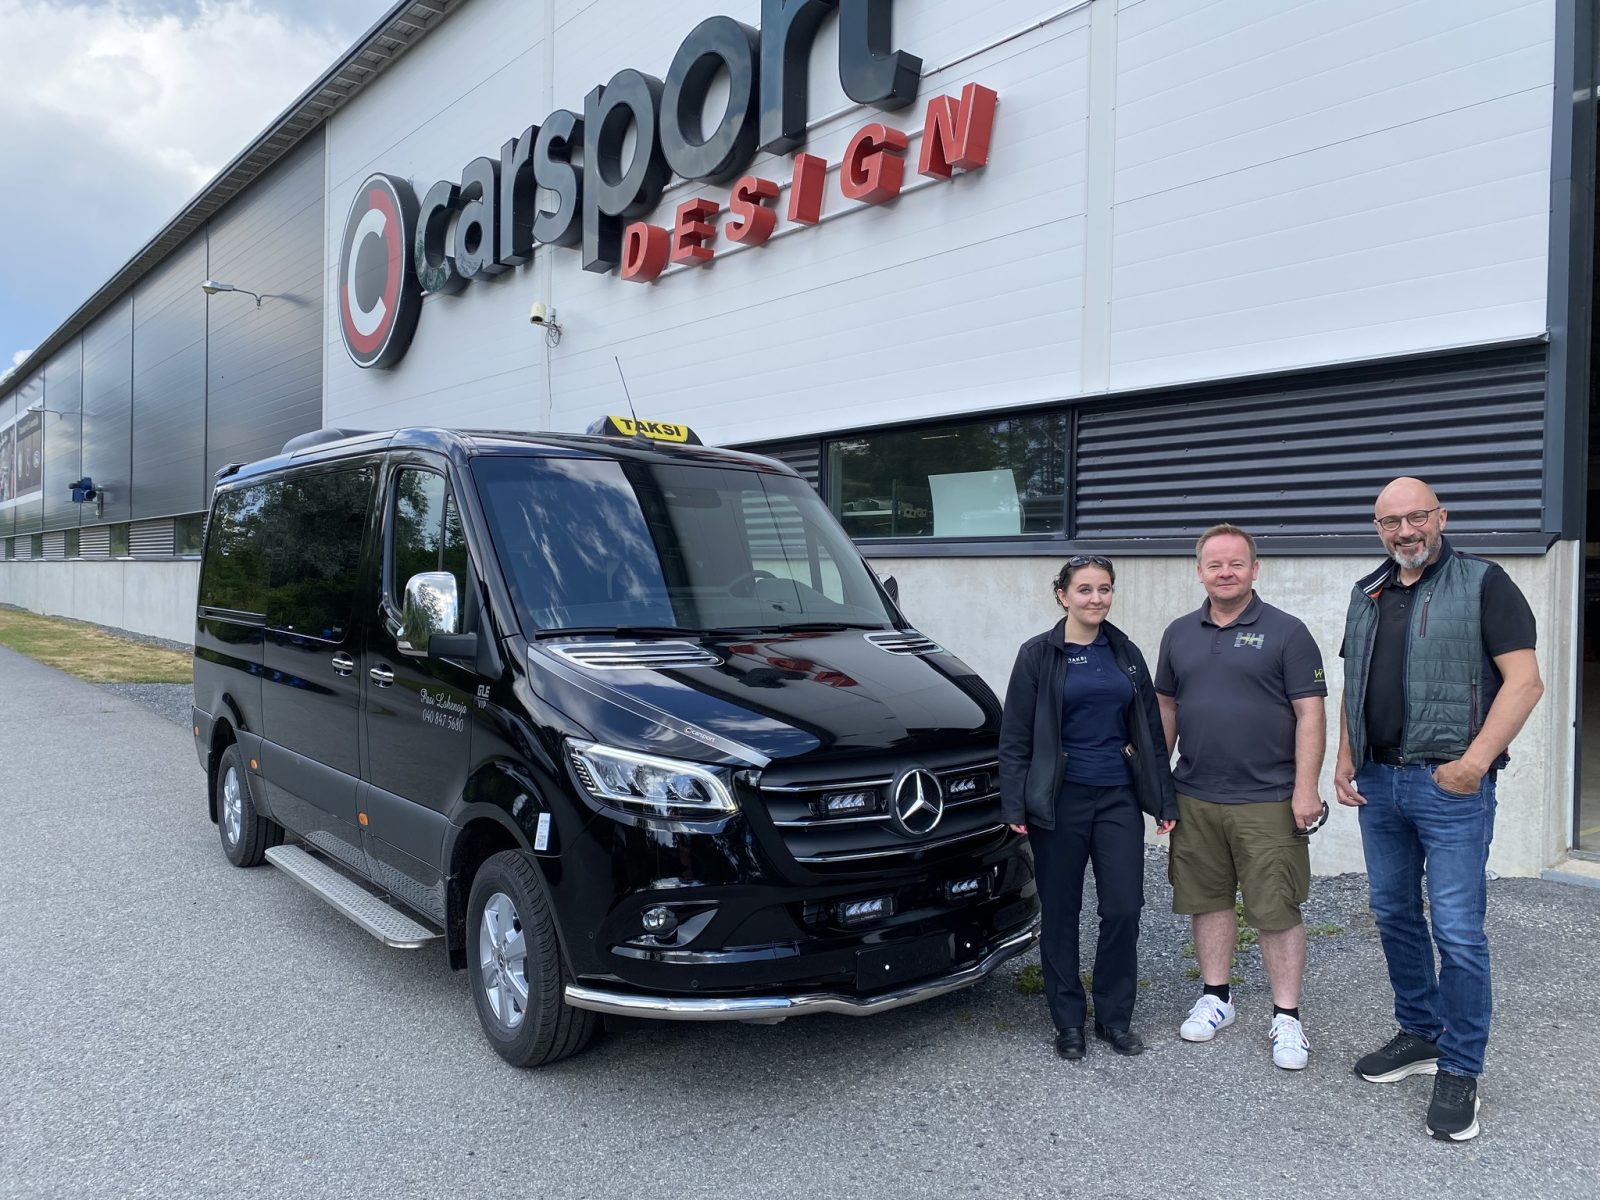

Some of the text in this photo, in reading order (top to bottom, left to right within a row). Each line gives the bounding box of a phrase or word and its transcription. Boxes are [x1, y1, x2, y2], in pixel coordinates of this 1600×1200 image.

[620, 82, 998, 283] DESIGN
[619, 418, 682, 437] TAKSI
[477, 684, 490, 697] GLE
[422, 708, 434, 723] 040
[447, 716, 463, 732] 5680
